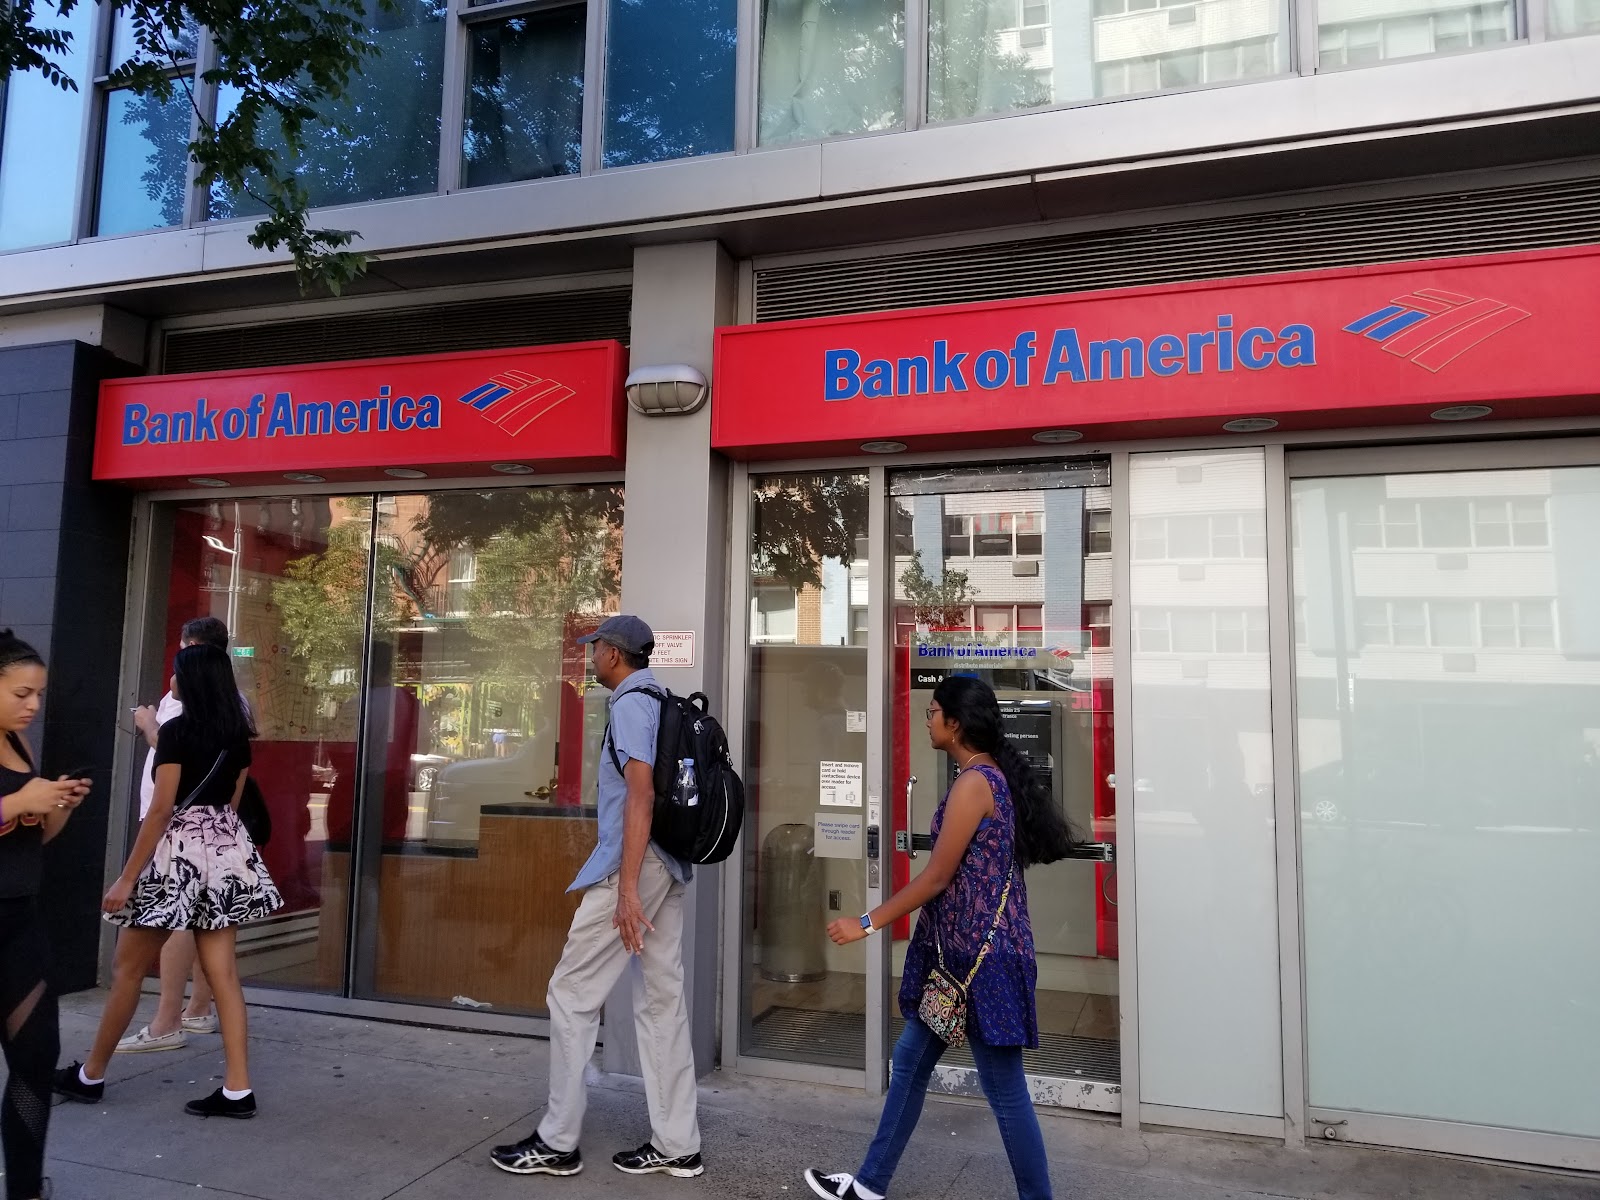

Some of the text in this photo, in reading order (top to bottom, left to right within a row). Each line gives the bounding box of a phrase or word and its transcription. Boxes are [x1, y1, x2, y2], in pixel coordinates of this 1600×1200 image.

[824, 314, 1317, 401] Bank of America
[122, 385, 442, 446] Bank of America
[918, 643, 955, 657] Bank
[974, 642, 1037, 657] America
[917, 674, 937, 683] Cash
